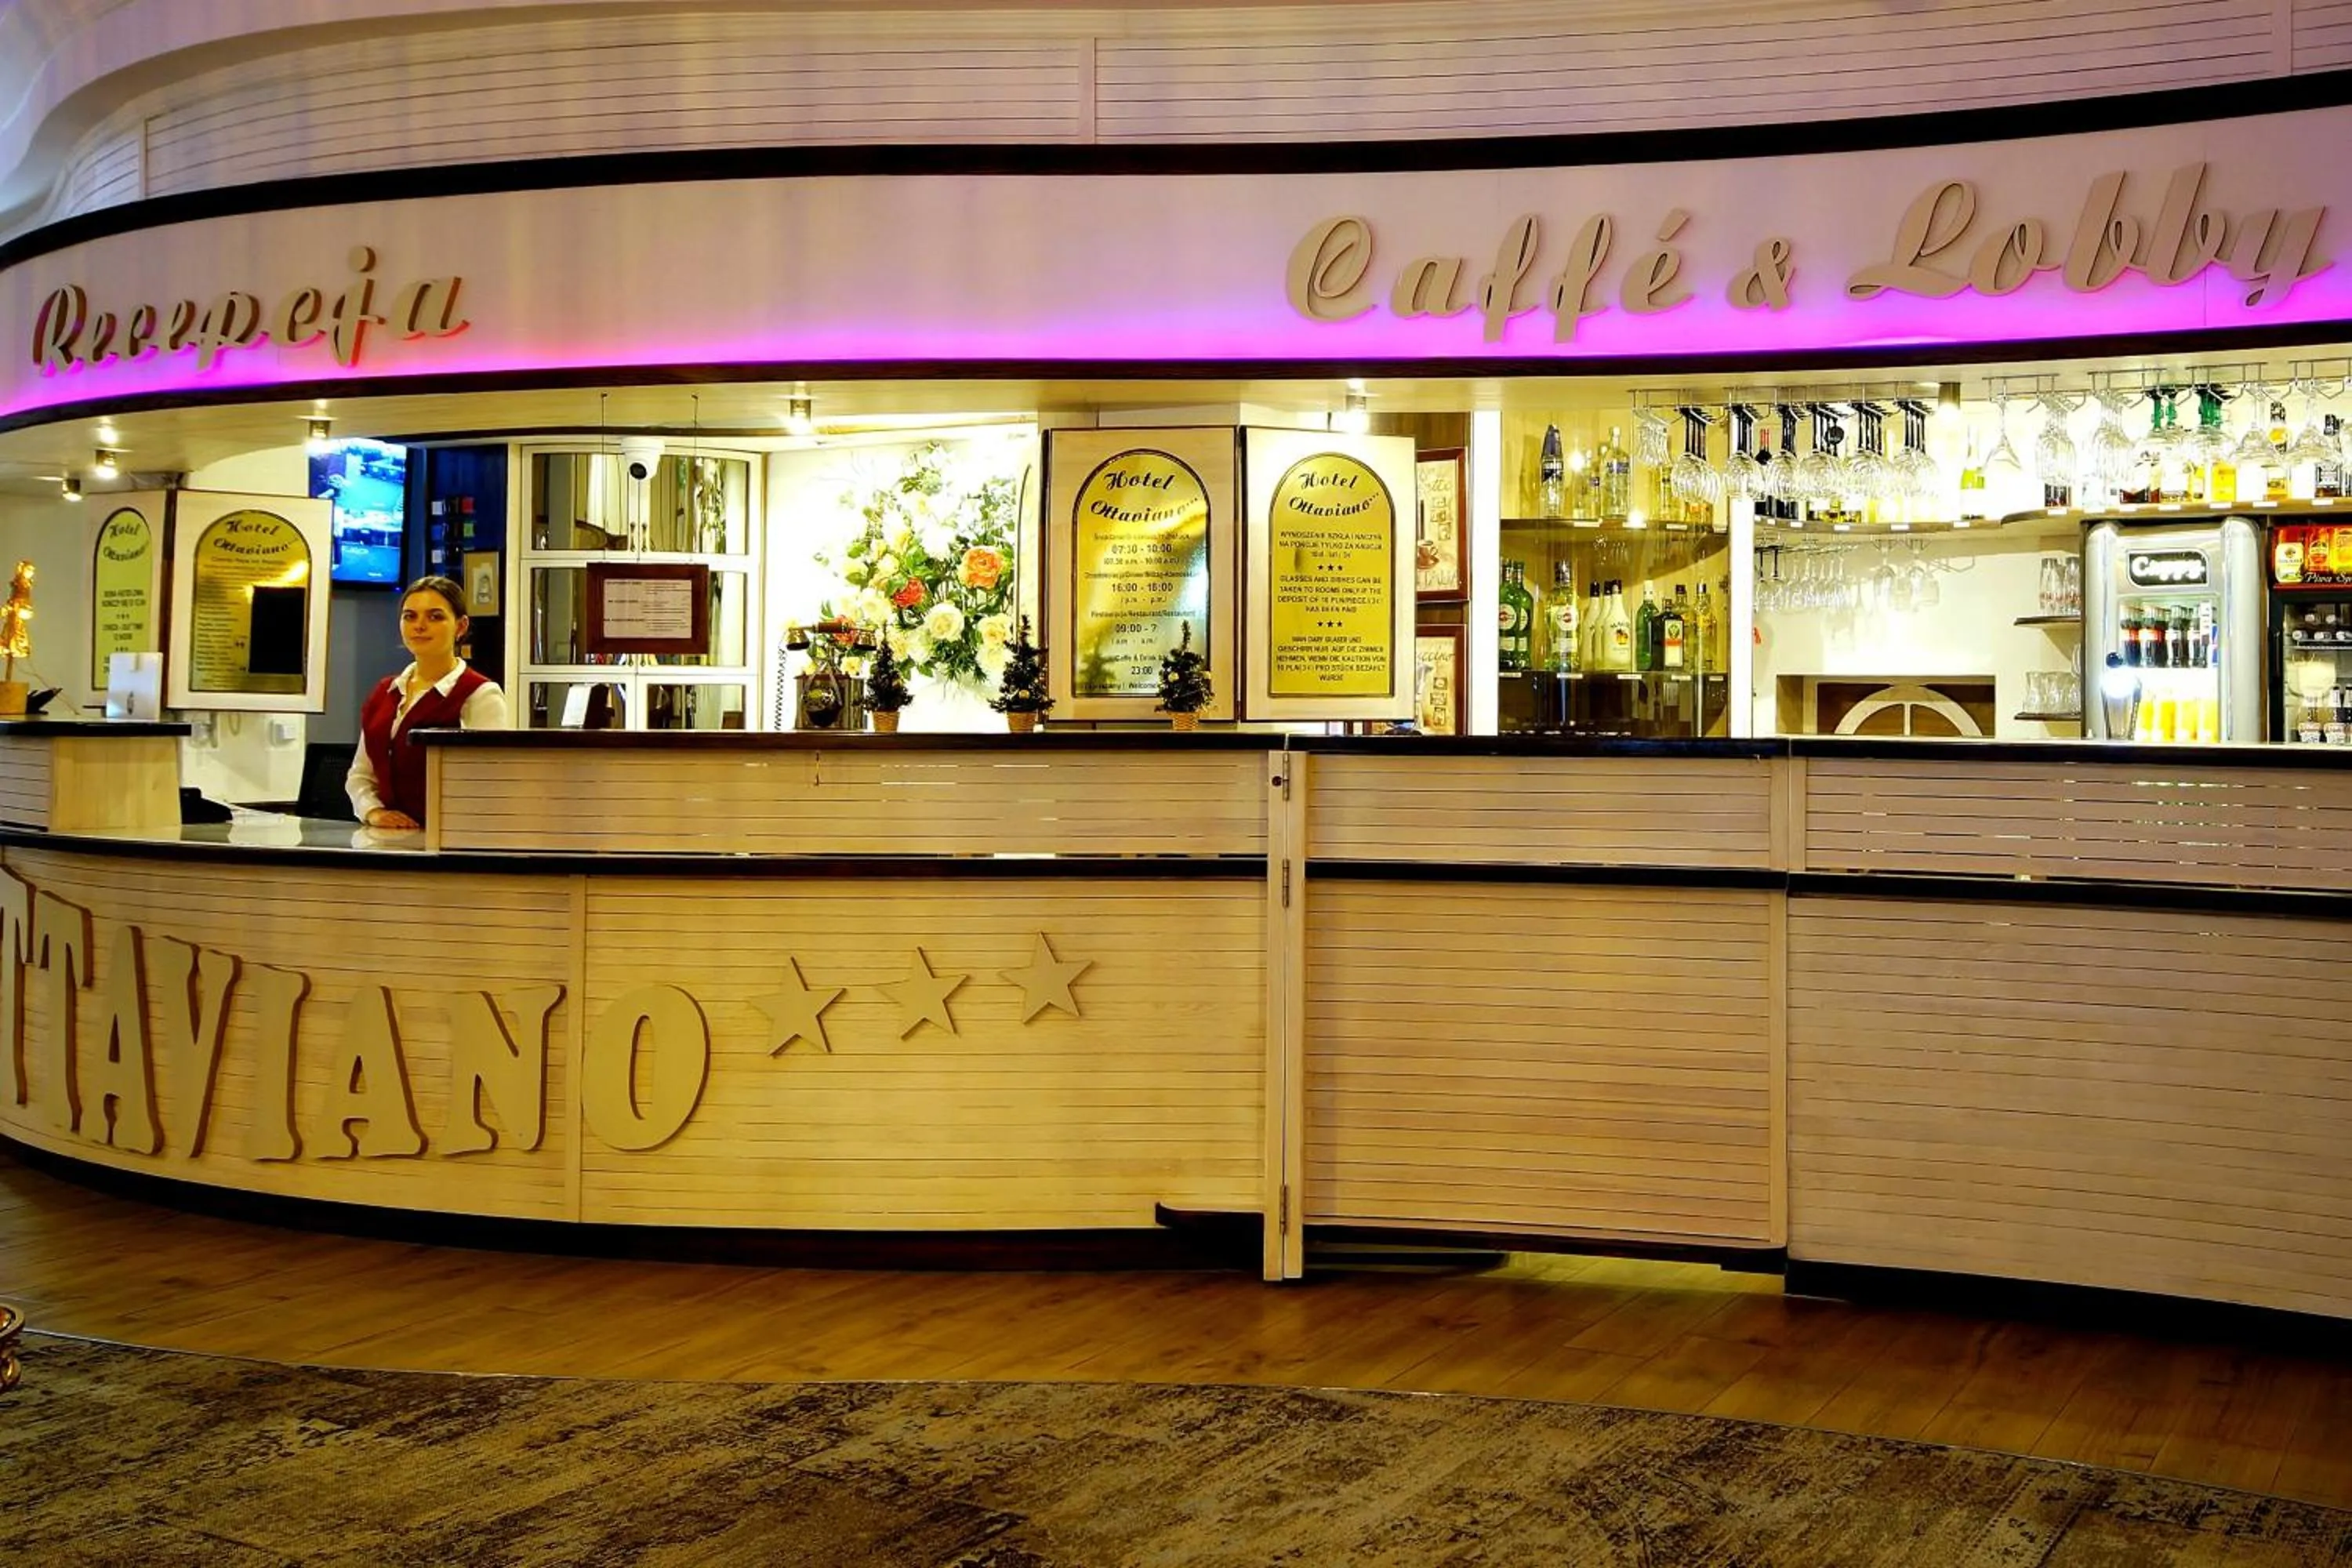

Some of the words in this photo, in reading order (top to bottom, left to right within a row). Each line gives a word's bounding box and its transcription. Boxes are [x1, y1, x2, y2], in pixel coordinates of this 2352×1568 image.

[1285, 209, 1694, 343] Caffé
[1727, 237, 1795, 311] &
[1845, 162, 2336, 310] Lobby
[1103, 470, 1175, 490] Hotel
[1298, 471, 1359, 490] Hotel
[1091, 498, 1186, 523] Ottaviano
[1289, 495, 1370, 517] Ottaviano
[109, 521, 141, 539] Hotel
[226, 520, 281, 535] Hotel
[1147, 543, 1172, 554] 10:00
